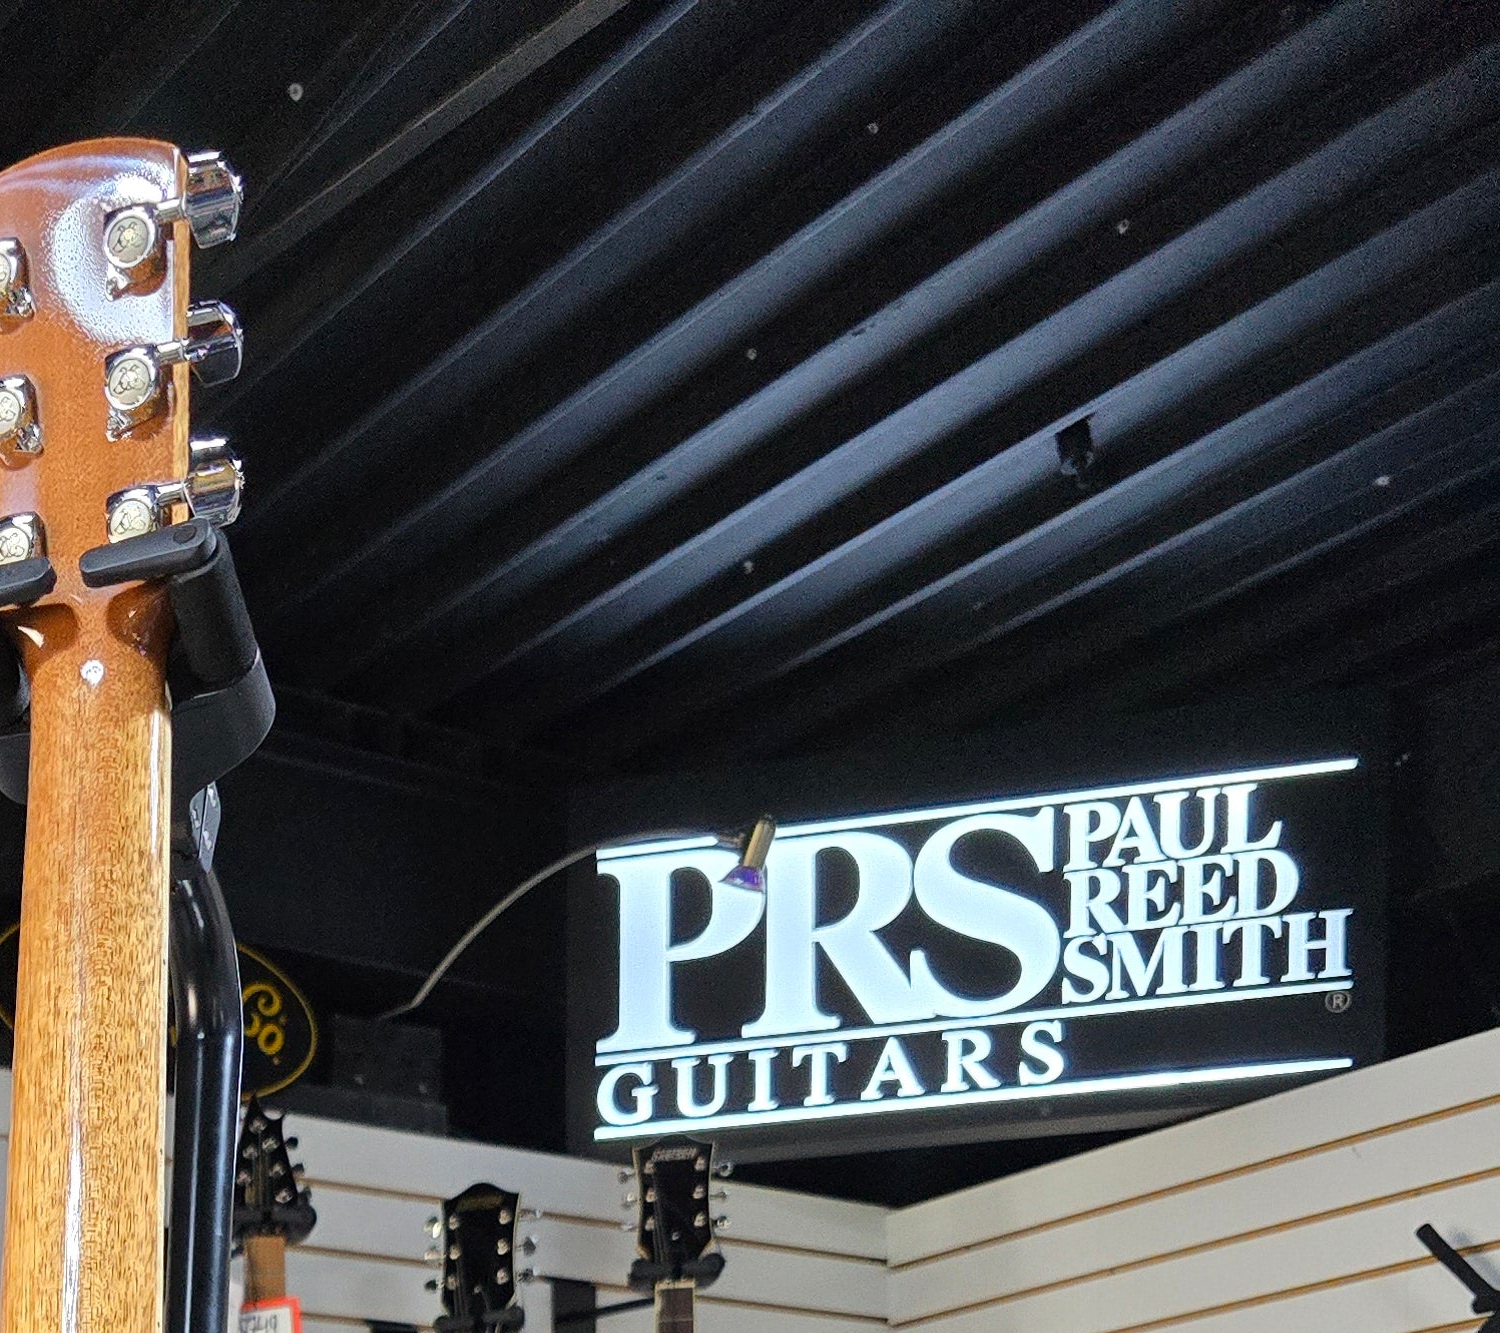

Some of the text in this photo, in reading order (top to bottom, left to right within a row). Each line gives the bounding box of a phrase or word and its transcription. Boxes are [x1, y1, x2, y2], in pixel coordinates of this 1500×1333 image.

[1065, 784, 1281, 871] PAUL
[596, 806, 1061, 1056] PRS
[1065, 849, 1300, 938] REED
[1061, 908, 1353, 1004] SMITH
[596, 1020, 1066, 1126] GUITARS
